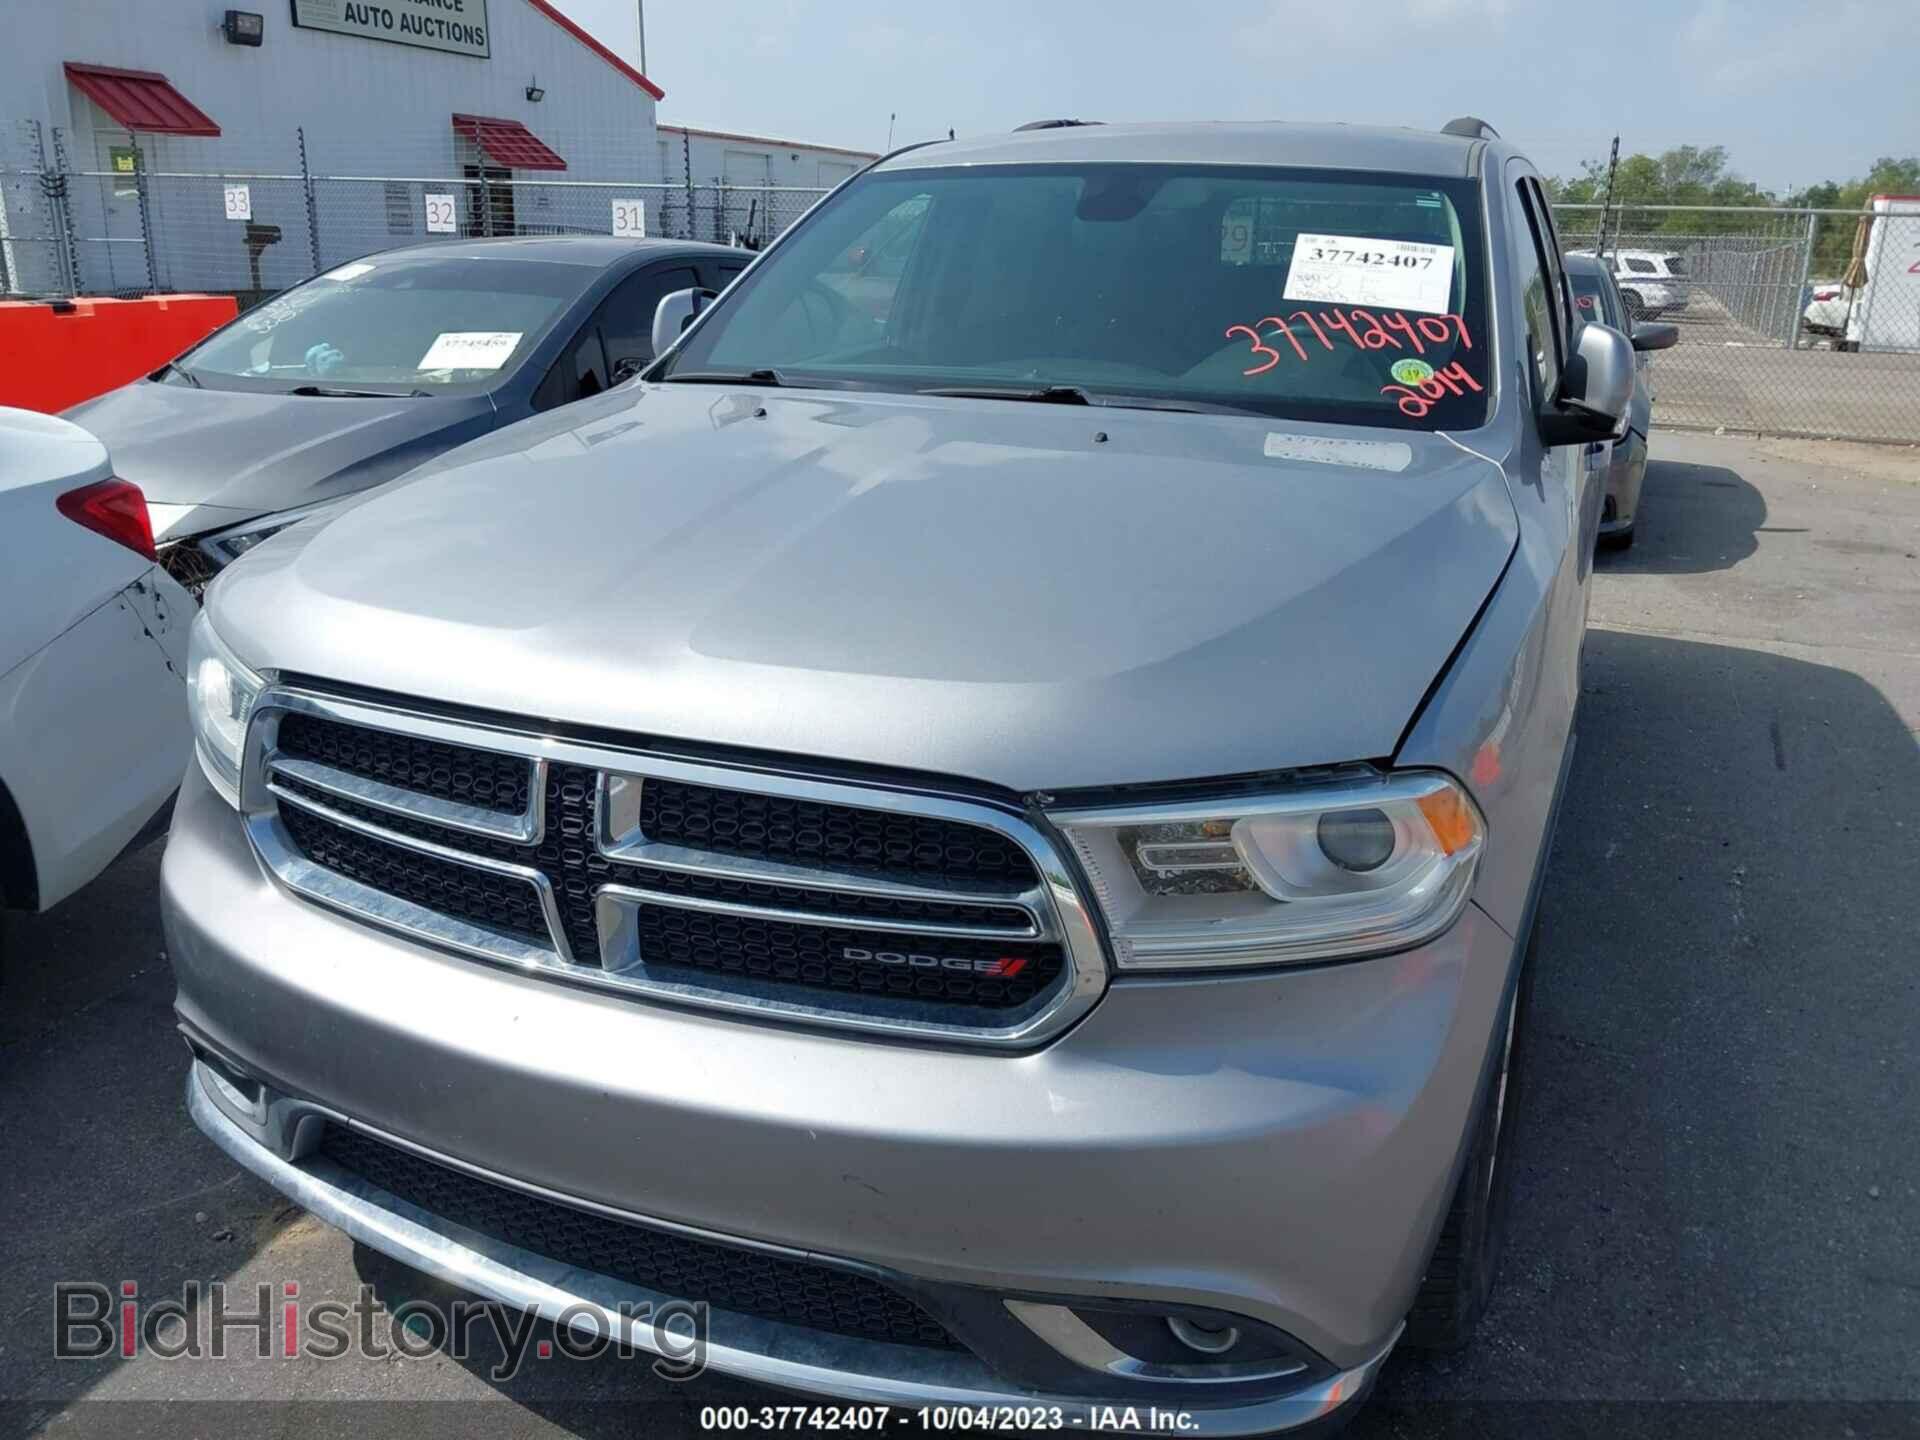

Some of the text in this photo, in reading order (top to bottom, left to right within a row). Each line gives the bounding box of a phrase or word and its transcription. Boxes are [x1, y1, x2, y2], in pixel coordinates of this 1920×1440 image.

[344, 2, 394, 30] AUTO
[400, 13, 485, 46] AUCTIONS
[226, 191, 249, 212] 33
[428, 202, 454, 225] 32
[615, 206, 642, 231] 31
[1308, 247, 1433, 271] 37742407
[1225, 308, 1473, 376] 37742407
[1379, 361, 1484, 417] 2014
[843, 947, 1003, 973] DODGE
